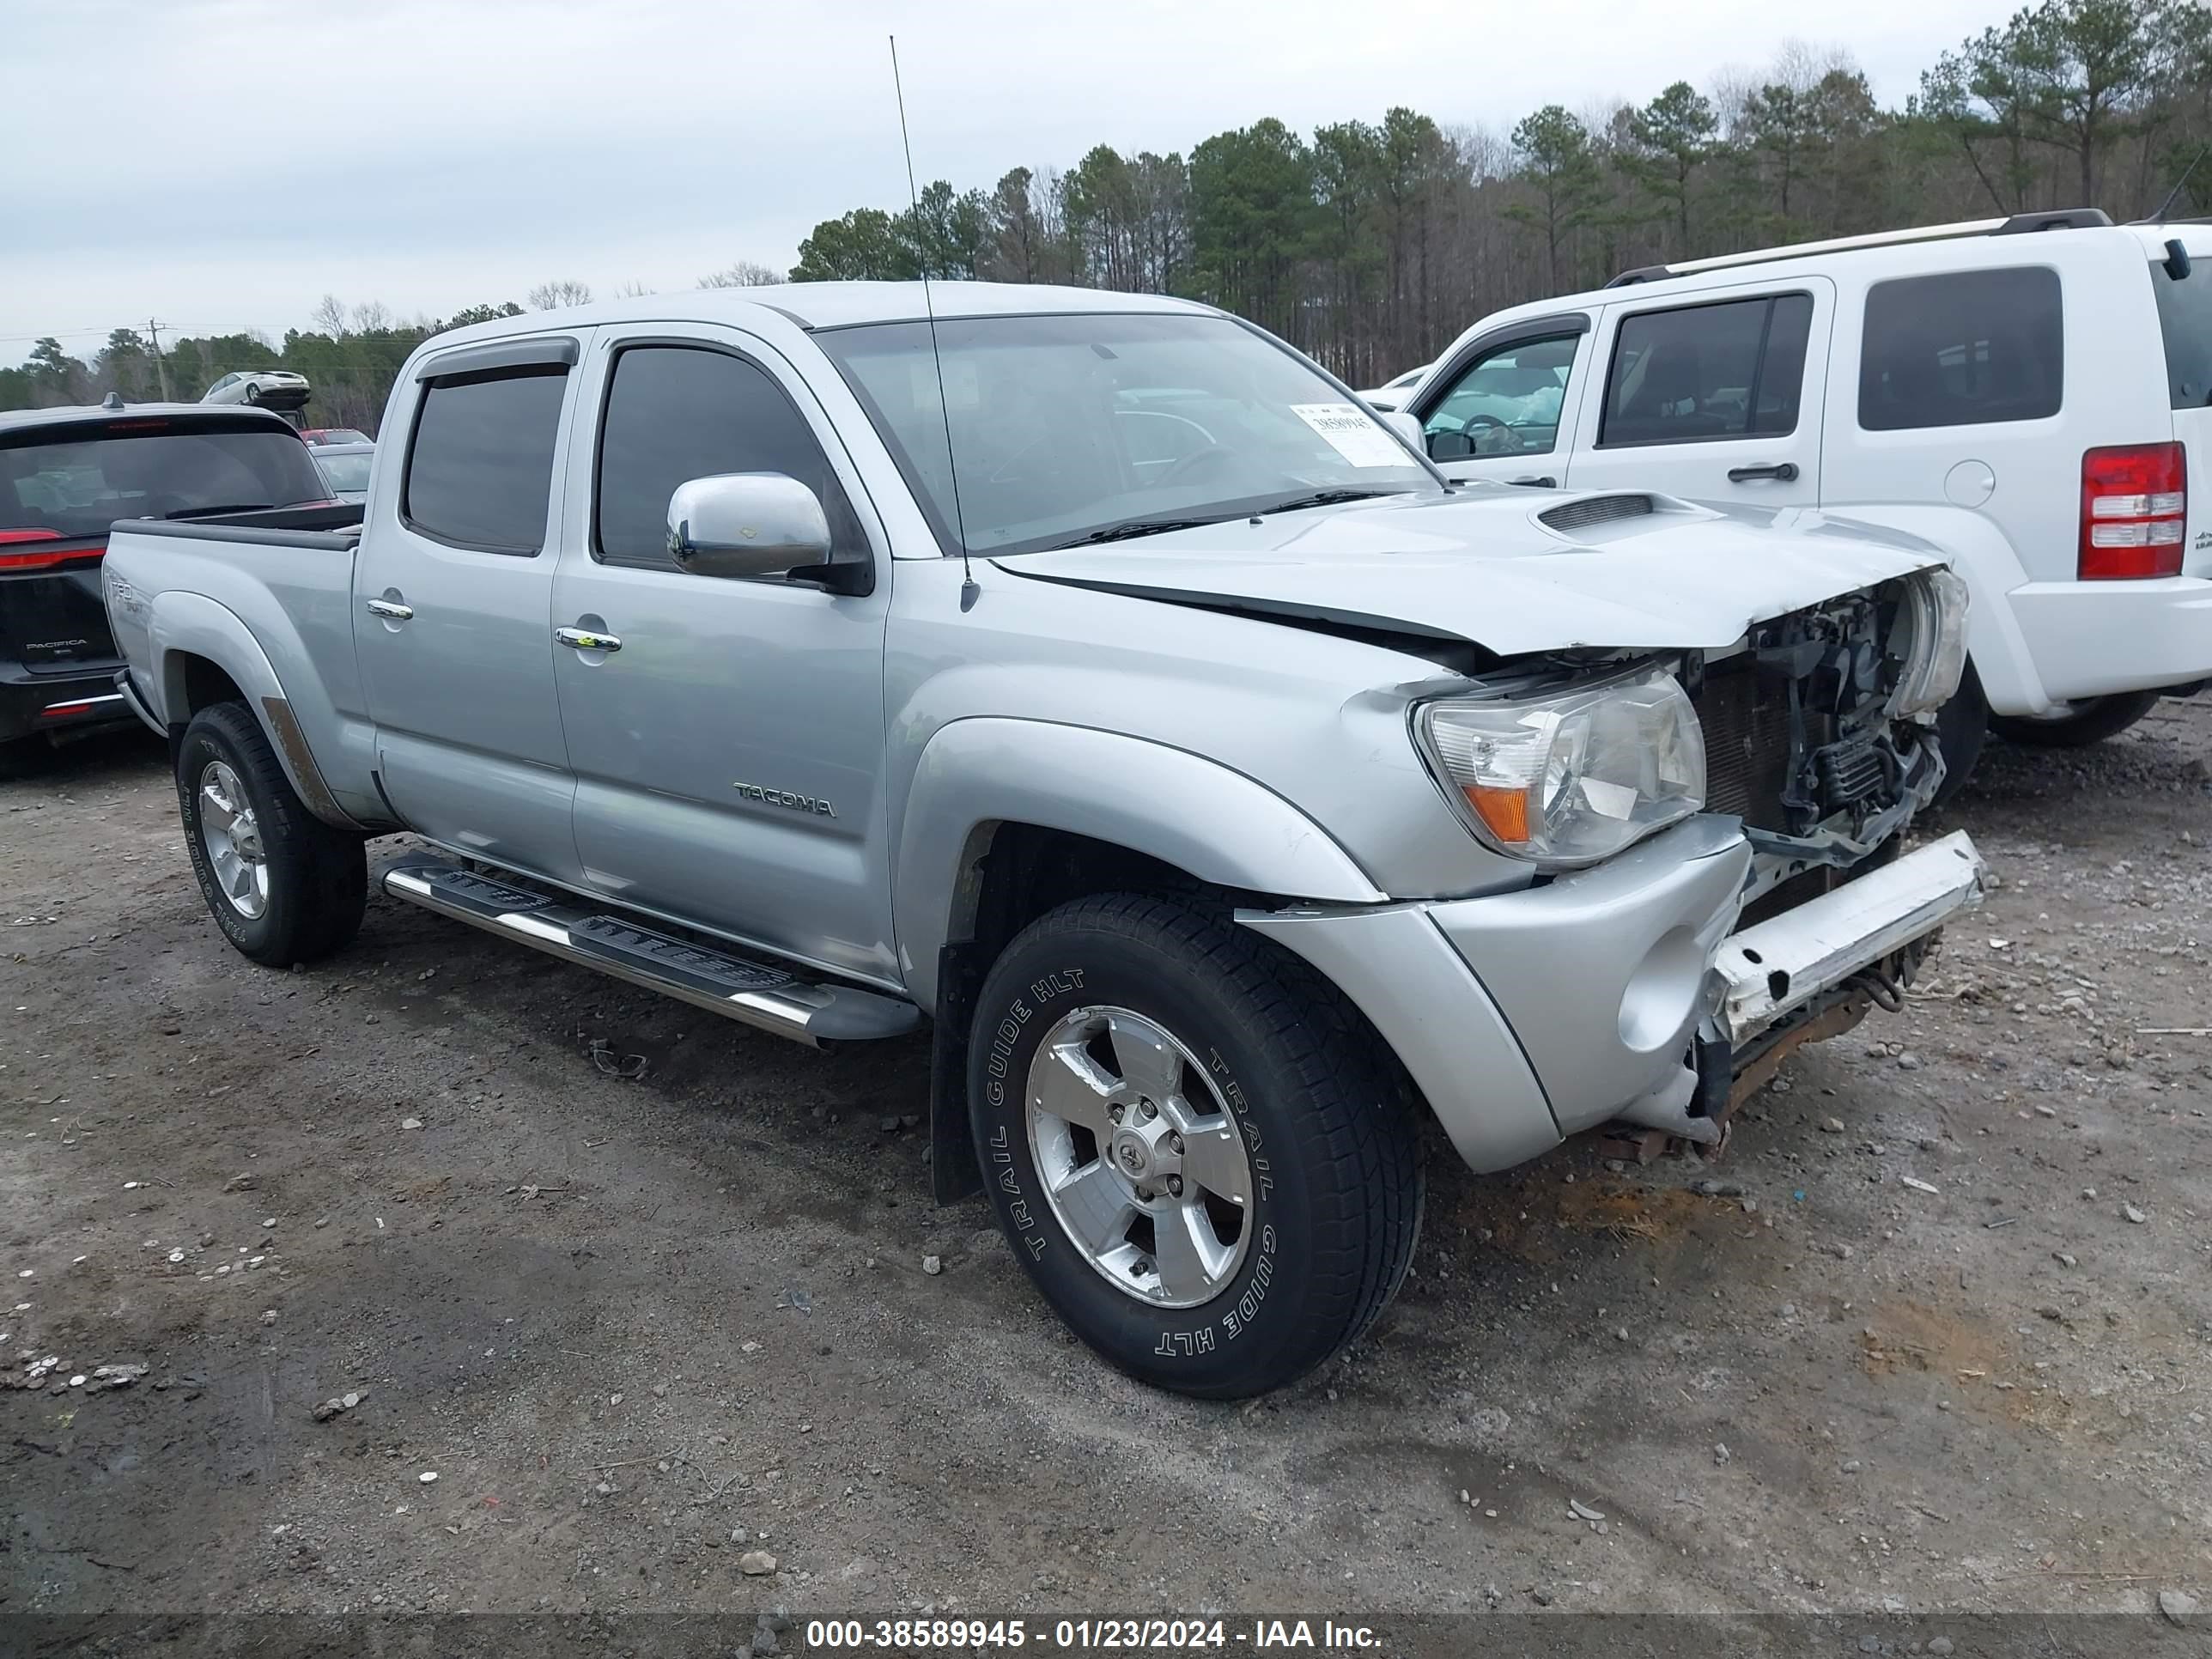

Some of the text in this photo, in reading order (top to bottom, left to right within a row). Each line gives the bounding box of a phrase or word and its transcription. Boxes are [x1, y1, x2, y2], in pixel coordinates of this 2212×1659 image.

[1313, 417, 1371, 430] 38589945
[26, 639, 88, 650] PACIFICA
[732, 781, 838, 818] TACOMA
[987, 969, 1084, 1261] TRAIL GUIDE HLT
[1154, 1047, 1277, 1357] TRAIL GUIDE HLT
